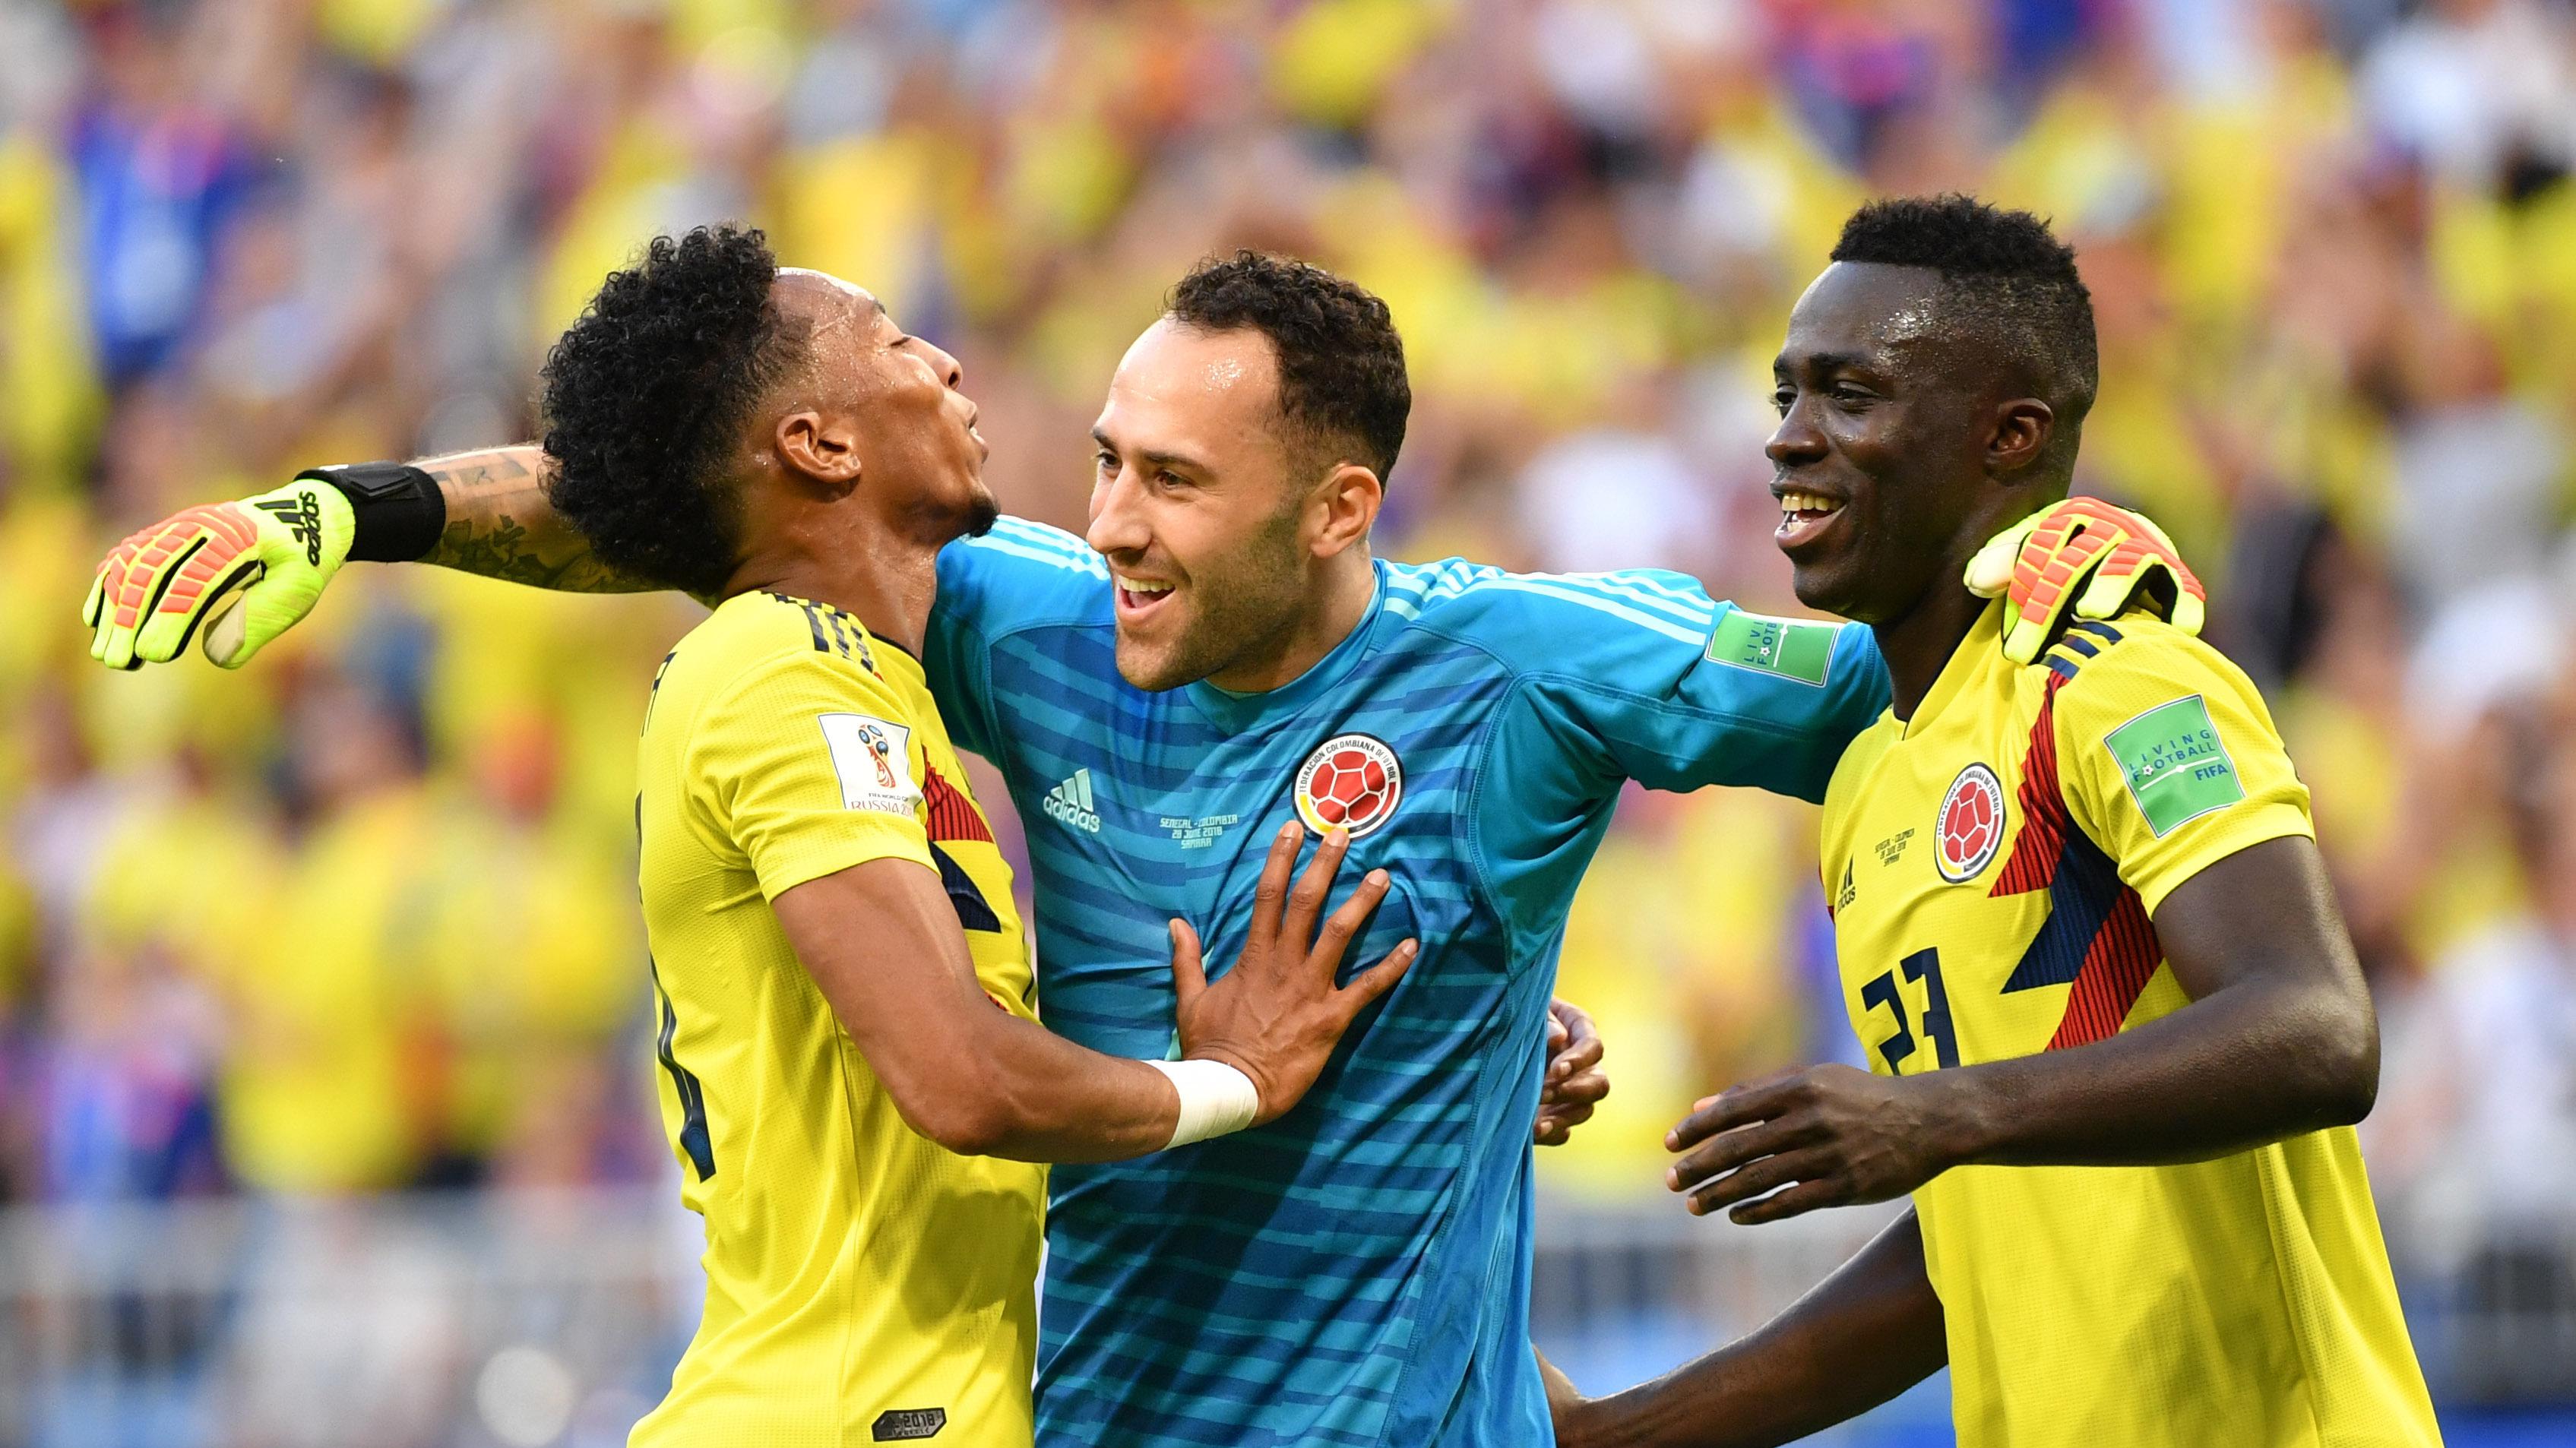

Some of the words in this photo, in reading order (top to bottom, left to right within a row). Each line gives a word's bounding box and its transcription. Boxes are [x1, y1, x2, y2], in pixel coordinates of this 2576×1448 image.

[299, 491, 321, 567] adidas
[1744, 621, 1764, 662] LIVI
[1325, 740, 1375, 754] COLOMBIANA
[2129, 729, 2210, 770] LIVING
[2195, 764, 2229, 781] FIFA
[851, 800, 900, 814] RUSSIA
[1043, 795, 1100, 833] adidas
[1160, 817, 1192, 829] SENEGAL
[1198, 814, 1238, 827] COLOMBIA
[1183, 829, 1201, 839] JUNE
[1203, 826, 1223, 836] 2018
[1181, 837, 1212, 849] SAMARA
[1861, 947, 1960, 1076] 23
[903, 1414, 936, 1427] 2018
